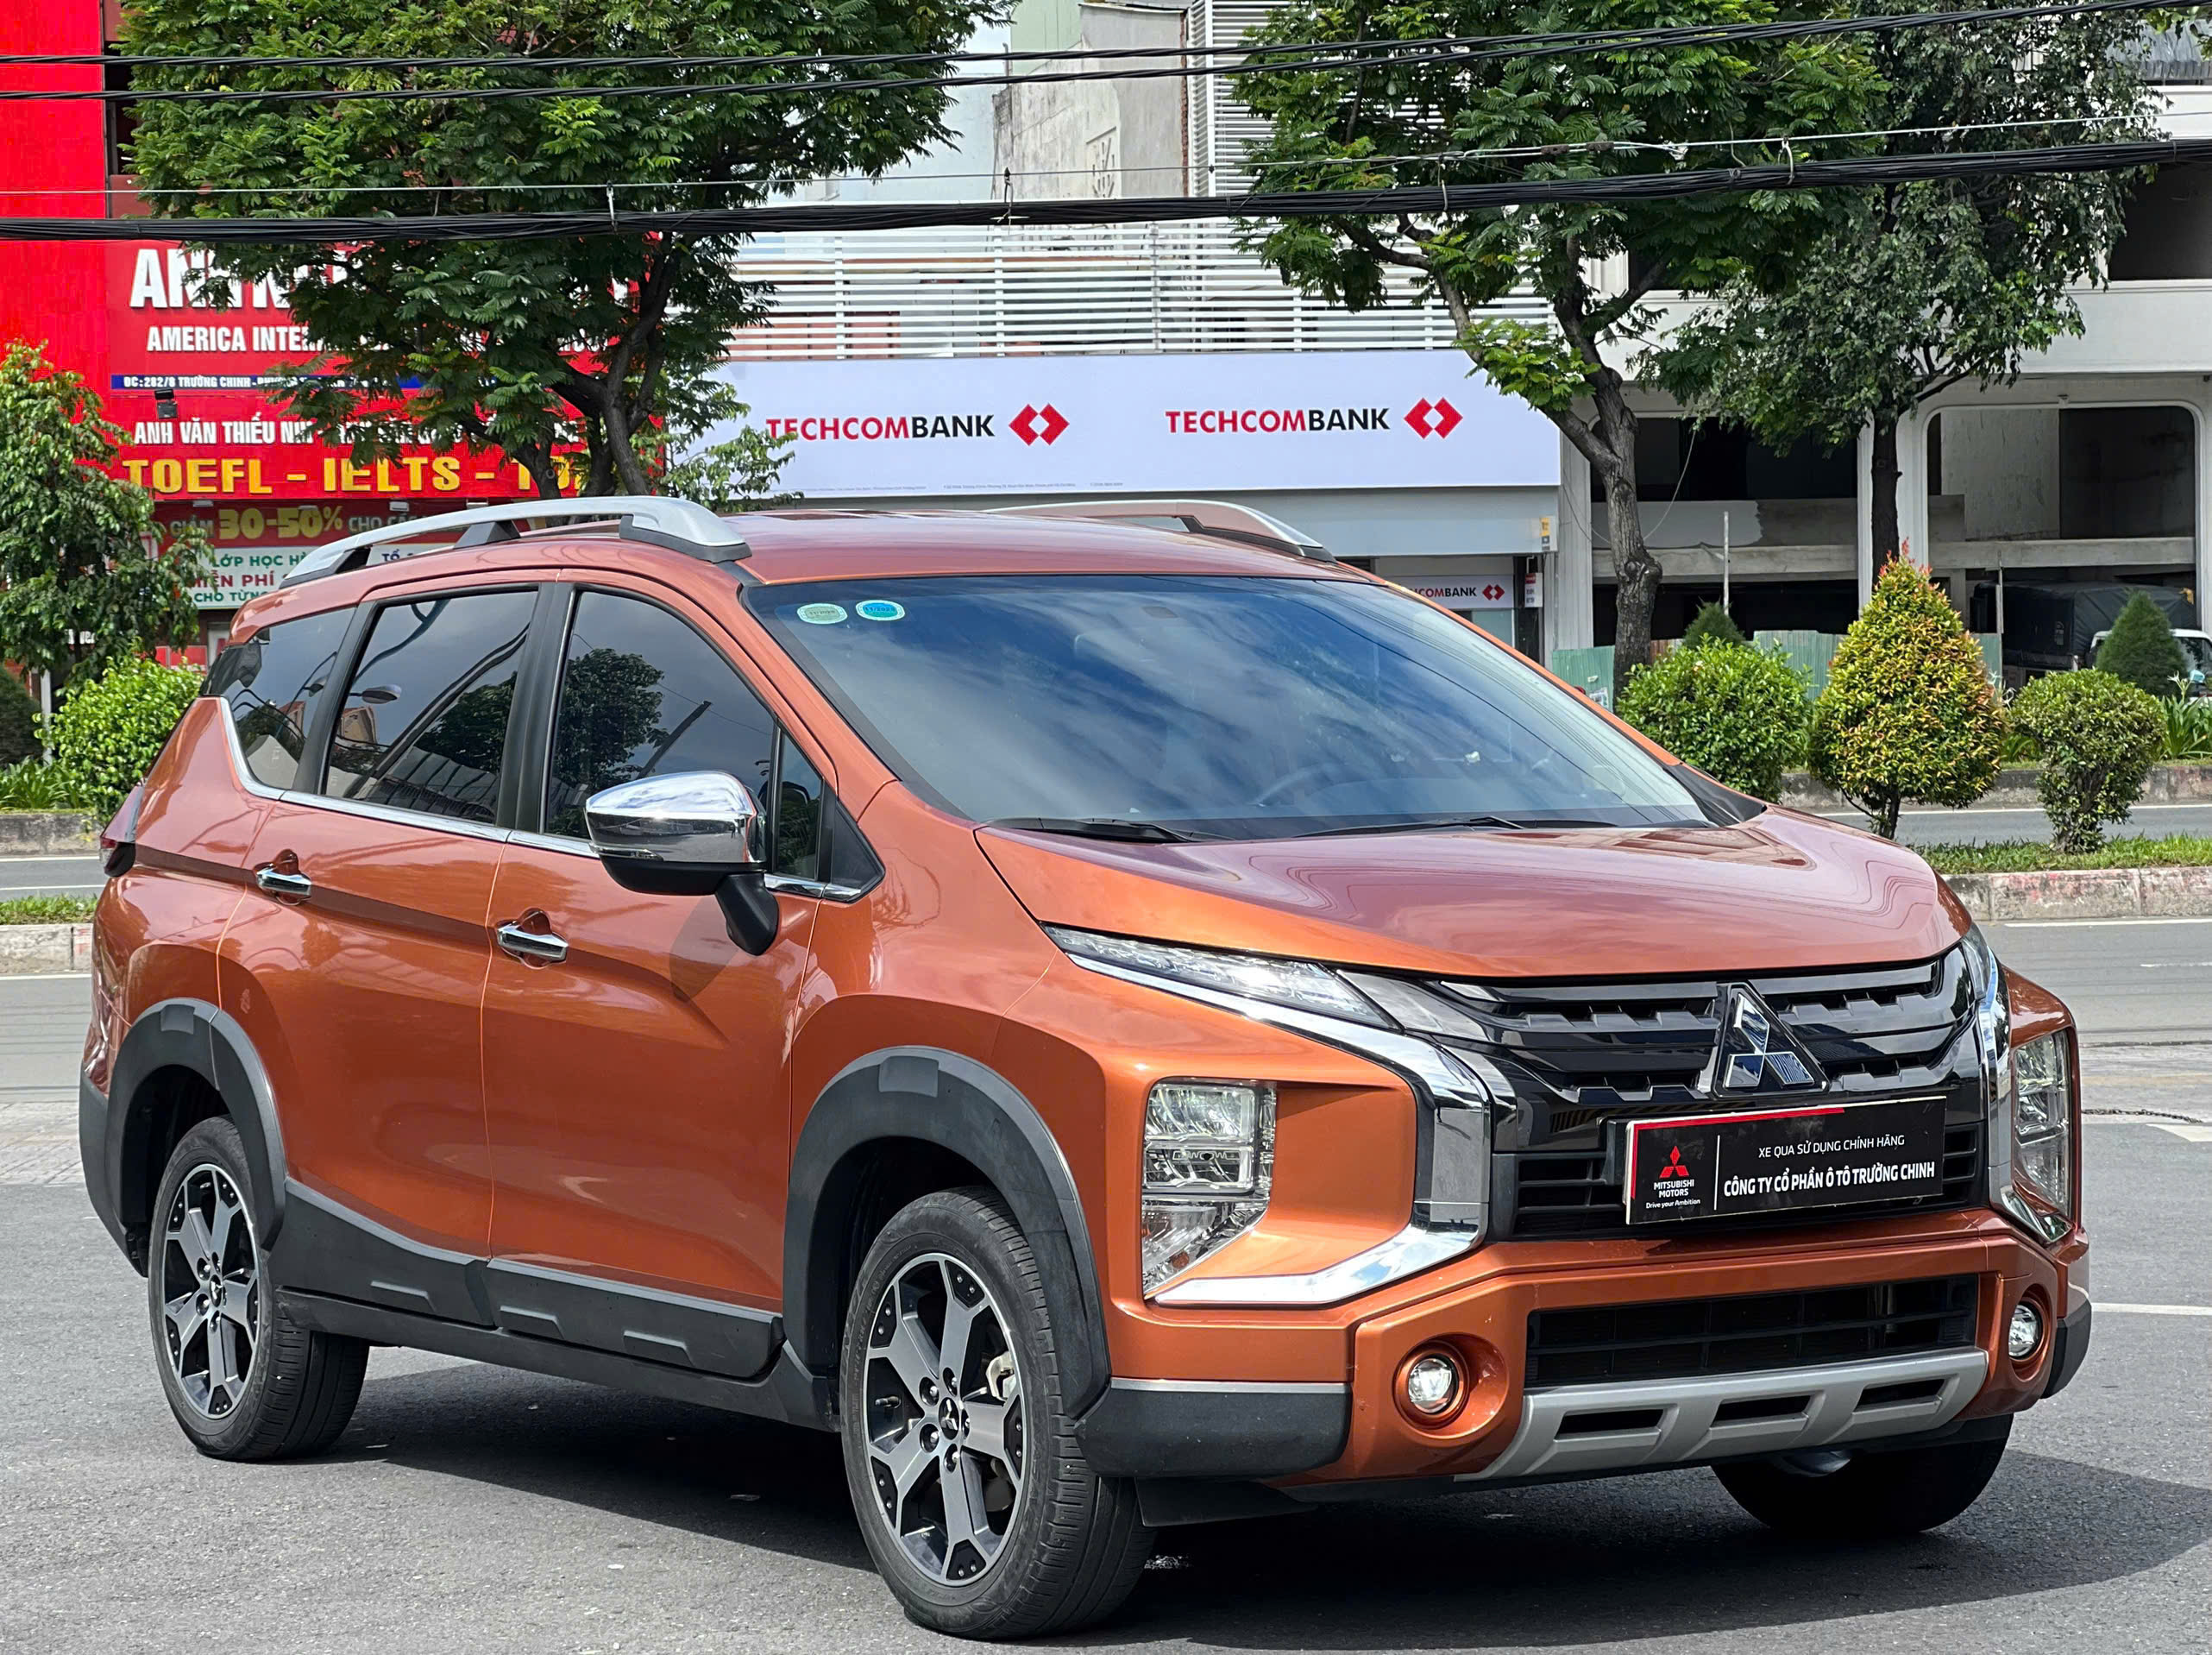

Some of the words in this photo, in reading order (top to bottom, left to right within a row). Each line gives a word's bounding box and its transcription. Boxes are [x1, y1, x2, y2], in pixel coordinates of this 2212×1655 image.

[147, 327, 247, 352] AMERICA
[135, 421, 173, 444] ANH
[179, 418, 216, 444] VĂN
[222, 411, 275, 444] THIẾU
[766, 415, 996, 441] TECHCOMBANK
[1165, 408, 1390, 433] TECHCOMBANK
[122, 458, 273, 494] TOEFL
[324, 456, 461, 492] IELTS
[219, 506, 342, 539] 30-50%
[249, 555, 283, 569] HỌC
[242, 570, 274, 587] PHÍ
[194, 592, 224, 602] CHO
[1758, 1147, 1771, 1158] XE
[1774, 1145, 1794, 1158] QUA
[1797, 1140, 1812, 1155] SỬ
[1813, 1141, 1841, 1155] DỤNG
[1843, 1136, 1874, 1150] CHÍNH
[1876, 1134, 1905, 1148] HÃNG
[1653, 1179, 1694, 1190] MITSUBISHI
[1724, 1175, 1756, 1197] CÔNG
[1757, 1176, 1773, 1193] TY
[1774, 1167, 1790, 1192] CỔ
[1791, 1167, 1824, 1191] PHẦN
[1826, 1167, 1834, 1187] Ô
[1836, 1165, 1851, 1186] TÔ
[1852, 1162, 1898, 1185] TRƯỜNG
[1901, 1161, 1935, 1180] CHINH
[1658, 1188, 1688, 1198] MOTORS
[1675, 1199, 1700, 1207] Ambition
